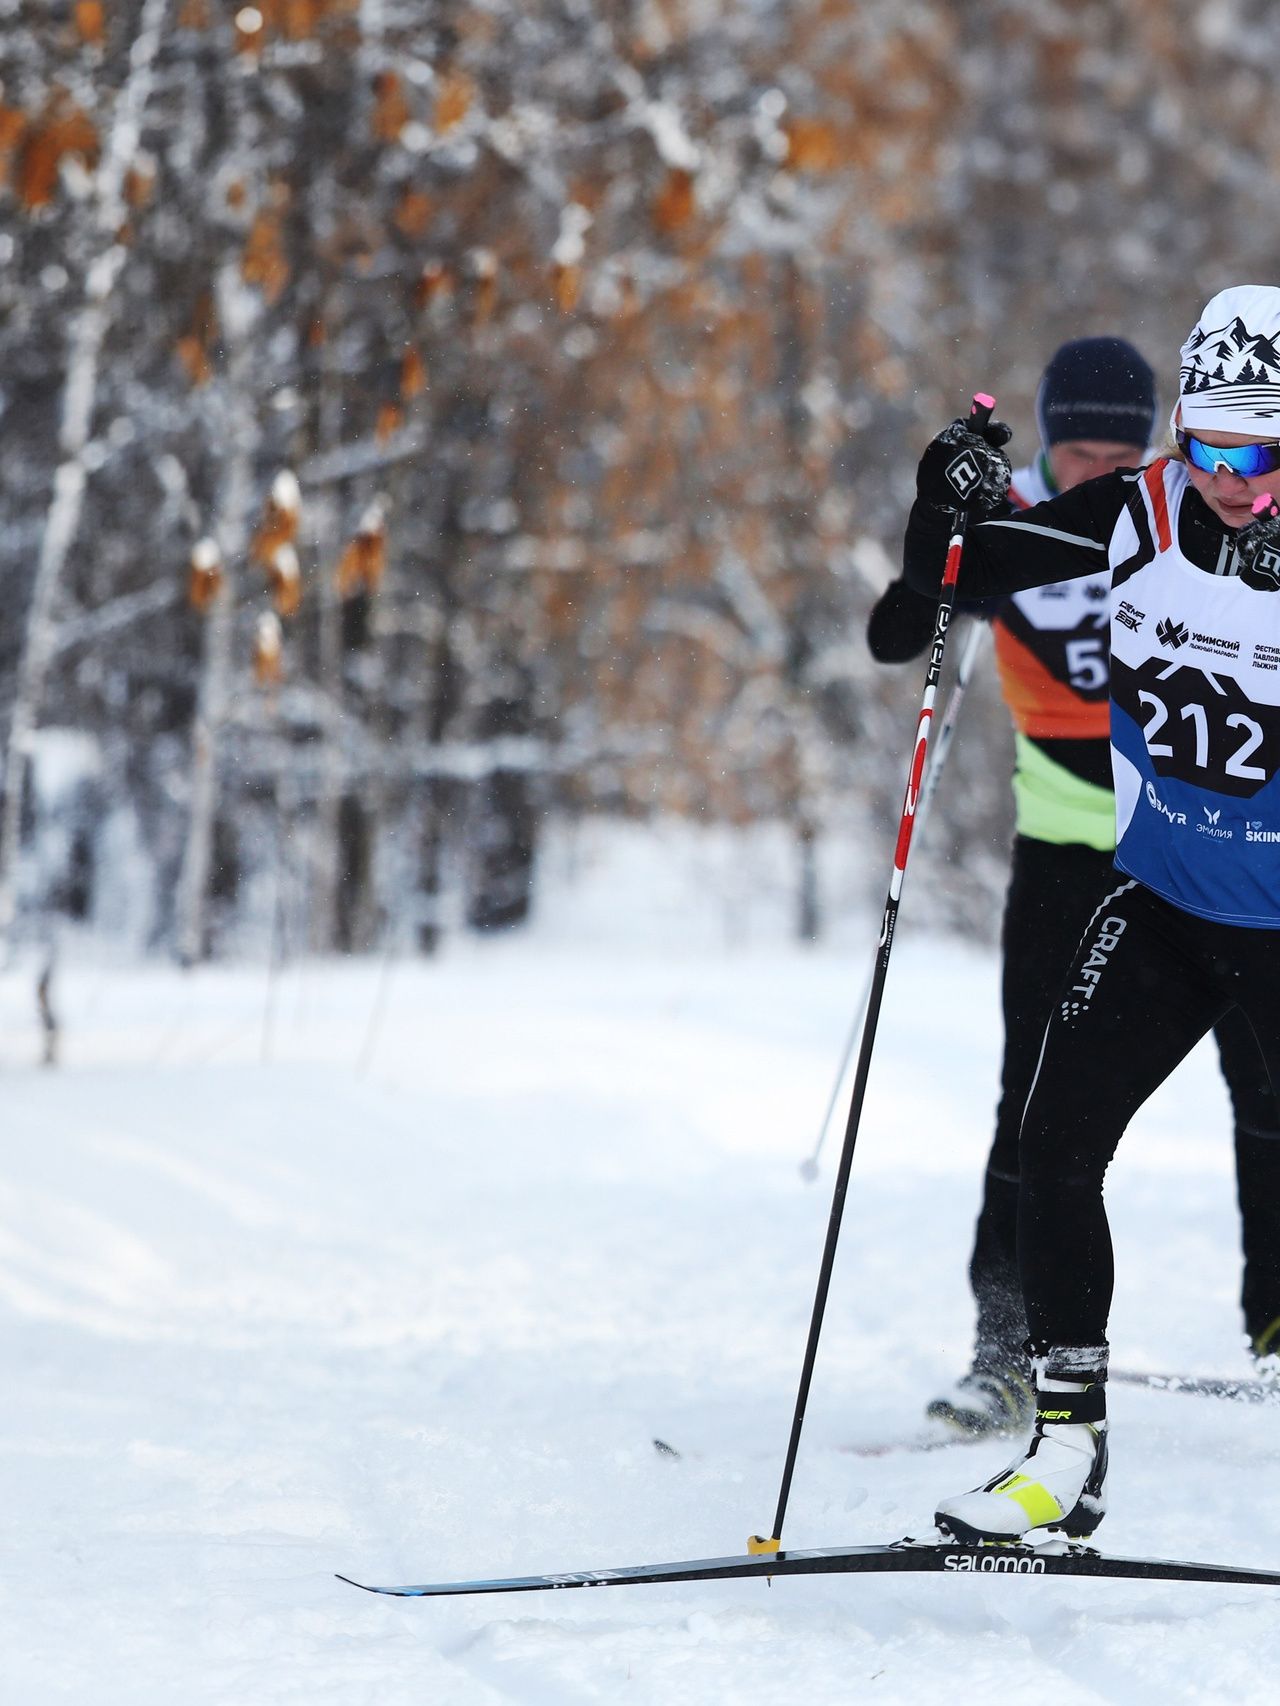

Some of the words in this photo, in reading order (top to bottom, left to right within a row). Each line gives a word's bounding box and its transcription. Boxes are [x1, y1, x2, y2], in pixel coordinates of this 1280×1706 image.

[1192, 632, 1240, 651] УФИМСКИЙ
[1213, 649, 1239, 659] МАРАФОН
[1252, 661, 1278, 671] ЛЫЖНЯ
[1137, 689, 1266, 781] 212
[1196, 823, 1233, 839] ЭМИЛИЯ
[1072, 916, 1128, 1000] CRAFT
